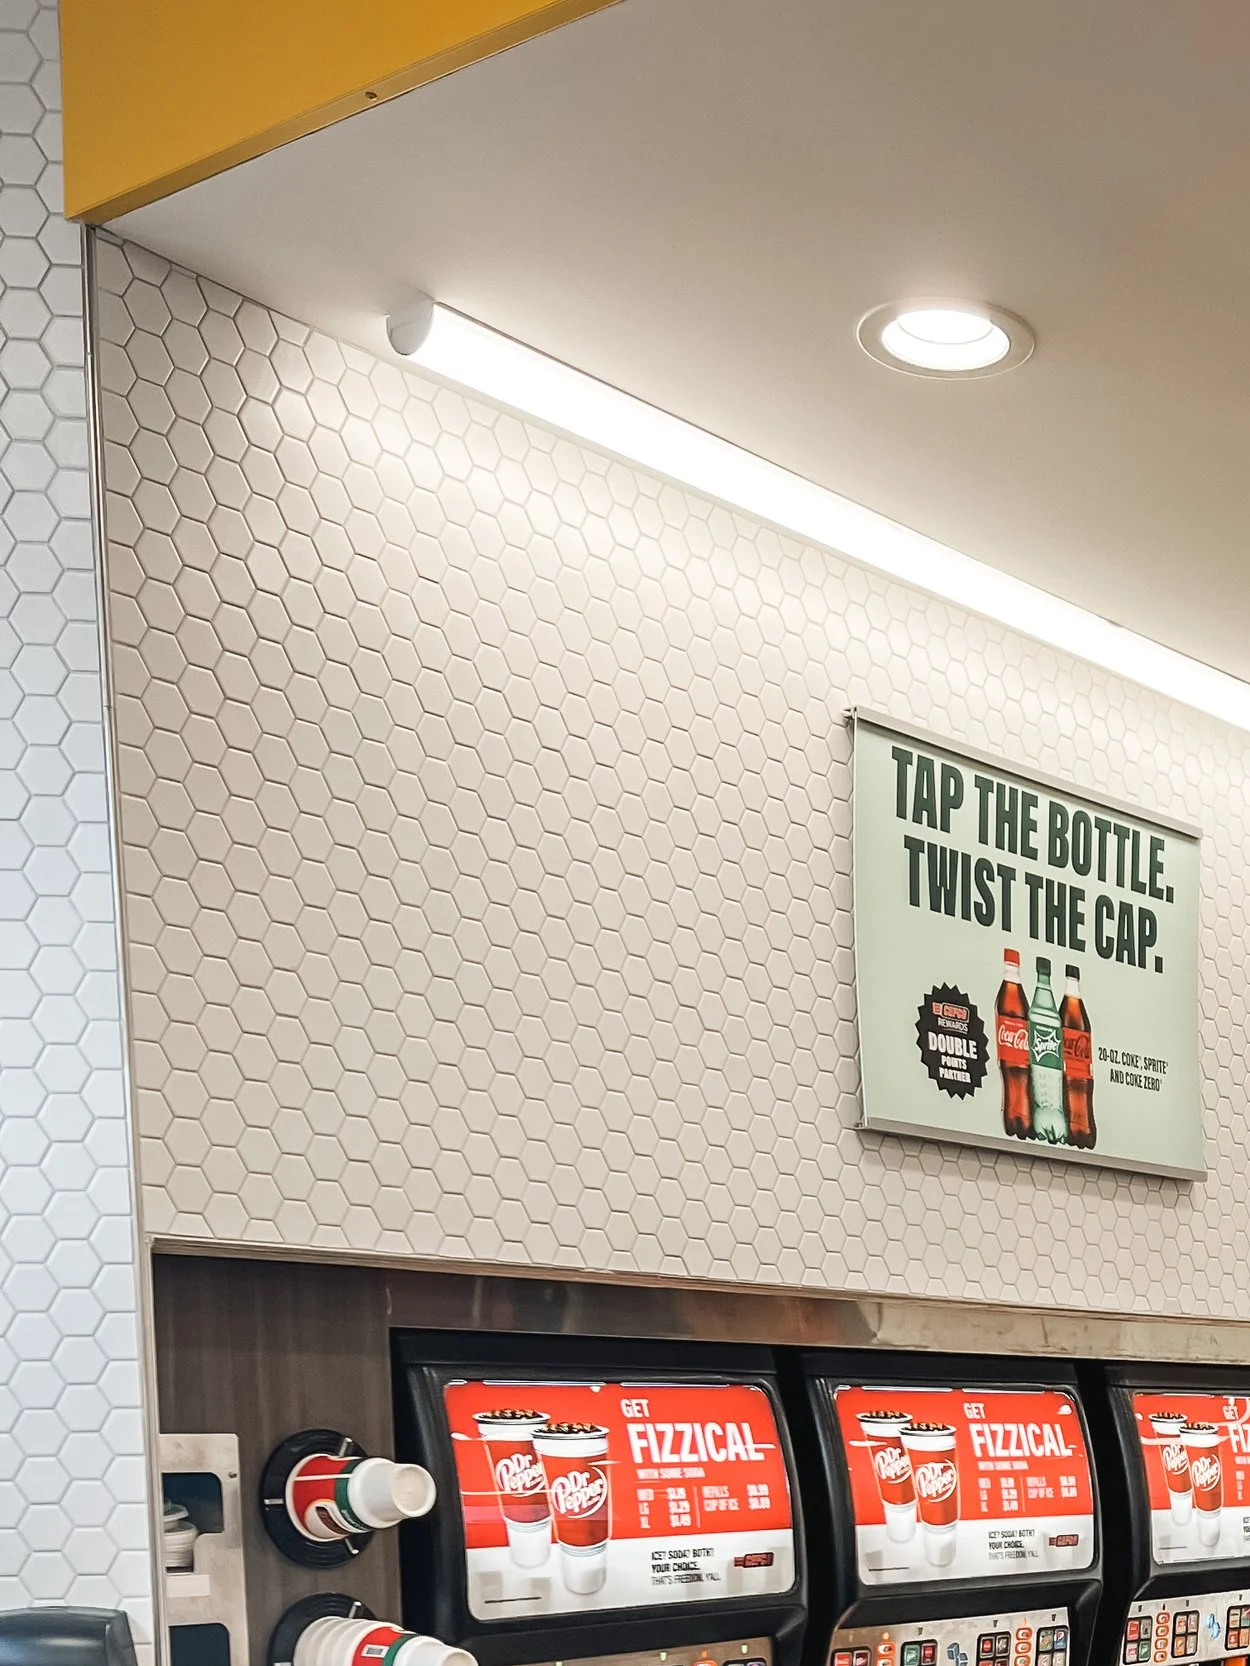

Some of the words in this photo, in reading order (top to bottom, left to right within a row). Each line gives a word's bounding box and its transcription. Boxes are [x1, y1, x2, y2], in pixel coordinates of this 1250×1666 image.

[892, 746, 963, 832] TAP
[974, 775, 1038, 860] THE
[1048, 801, 1174, 903] BOTTLE.
[904, 835, 1016, 932] TWIST
[1025, 871, 1086, 952] THE
[1095, 895, 1163, 972] CAP.
[938, 1018, 968, 1032] REWARDS
[928, 1032, 978, 1059] DOUBLE
[1034, 1038, 1057, 1053] Sprite
[941, 1055, 967, 1069] POINTS
[1098, 1047, 1121, 1064] 20-OZ.
[939, 1067, 971, 1083] PARTNER
[1110, 1069, 1124, 1083] AND
[1125, 1072, 1142, 1087] COKE
[620, 1398, 650, 1419] GET
[963, 1403, 985, 1419] GET
[1223, 1405, 1239, 1420] GET
[626, 1422, 765, 1464] FIZZICAL
[969, 1424, 1072, 1457] FIZZICAL
[511, 1453, 532, 1473] Dr
[884, 1447, 901, 1461] Dr
[928, 1462, 944, 1477] Dr
[1199, 1456, 1211, 1471] Dr
[567, 1471, 590, 1490] Dr
[916, 1467, 954, 1498] Pepper
[551, 1476, 604, 1514] Pepper
